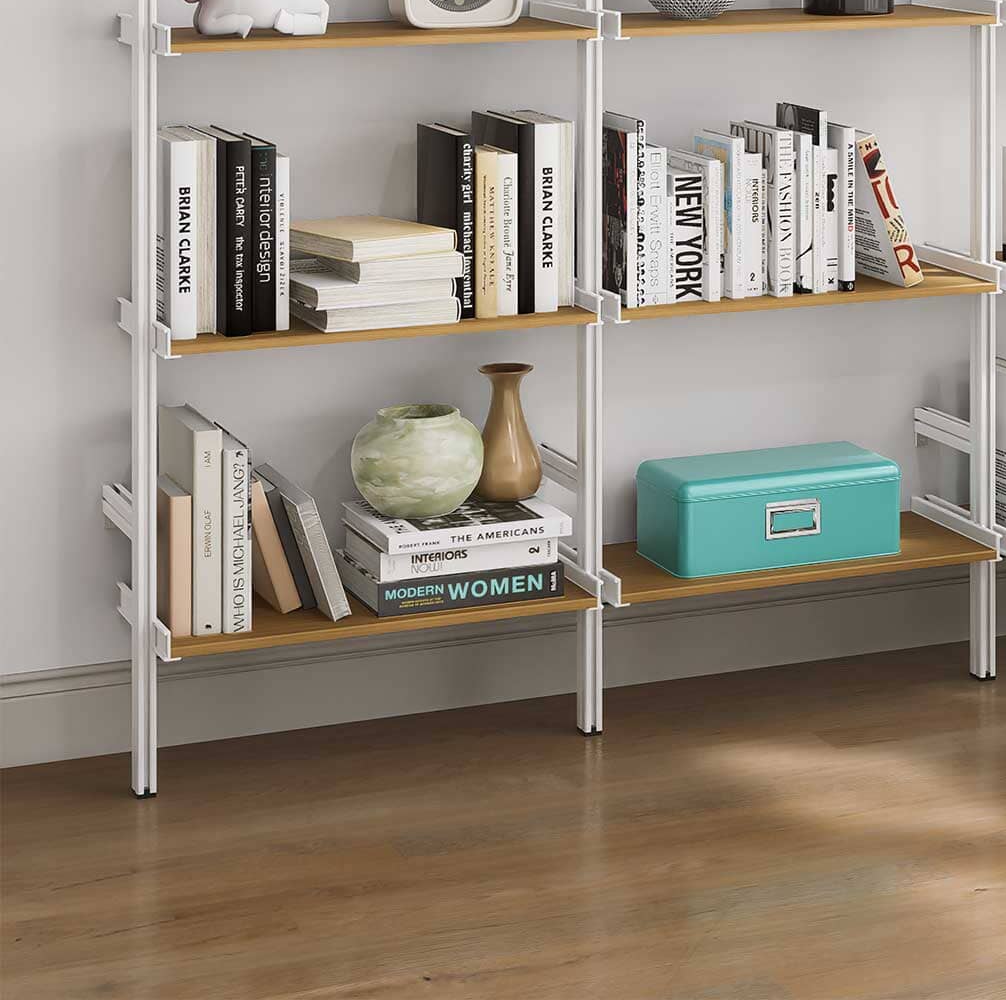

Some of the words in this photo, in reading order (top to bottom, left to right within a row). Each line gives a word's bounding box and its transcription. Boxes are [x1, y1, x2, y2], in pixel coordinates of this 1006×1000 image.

[462, 144, 472, 181] charity
[780, 132, 792, 168] THE
[236, 166, 245, 194] PETER
[462, 184, 472, 204] girl
[503, 177, 512, 216] Charlotte
[542, 167, 553, 212] BRIAN
[848, 180, 854, 188] IN
[179, 186, 191, 233] BRIAN
[236, 197, 244, 226] CAREY
[650, 195, 661, 234] Erwitt
[675, 176, 702, 228] NEW
[780, 172, 792, 242] FASHION
[236, 236, 244, 250] the
[464, 212, 472, 252] michael
[503, 218, 512, 248] Brontë
[542, 216, 553, 268] CLARKE
[179, 238, 191, 293] CLARKE
[236, 253, 244, 266] tax
[503, 250, 514, 271] Jane
[648, 240, 662, 287] Snaps
[675, 234, 702, 299] YORK
[750, 272, 756, 282] 2
[780, 247, 792, 294] BOOK
[234, 270, 244, 312] inspector
[502, 273, 514, 292] Eyre
[233, 462, 244, 508] JANG?
[233, 511, 244, 575] MICHAEL
[451, 534, 472, 543] THE
[477, 526, 545, 542] AMERICANS
[411, 549, 468, 564] INTERIORS
[528, 546, 540, 554] 2
[233, 578, 244, 591] IS
[384, 584, 444, 600] MODERN
[448, 573, 544, 600] WOMEN
[233, 594, 244, 632] WHO
